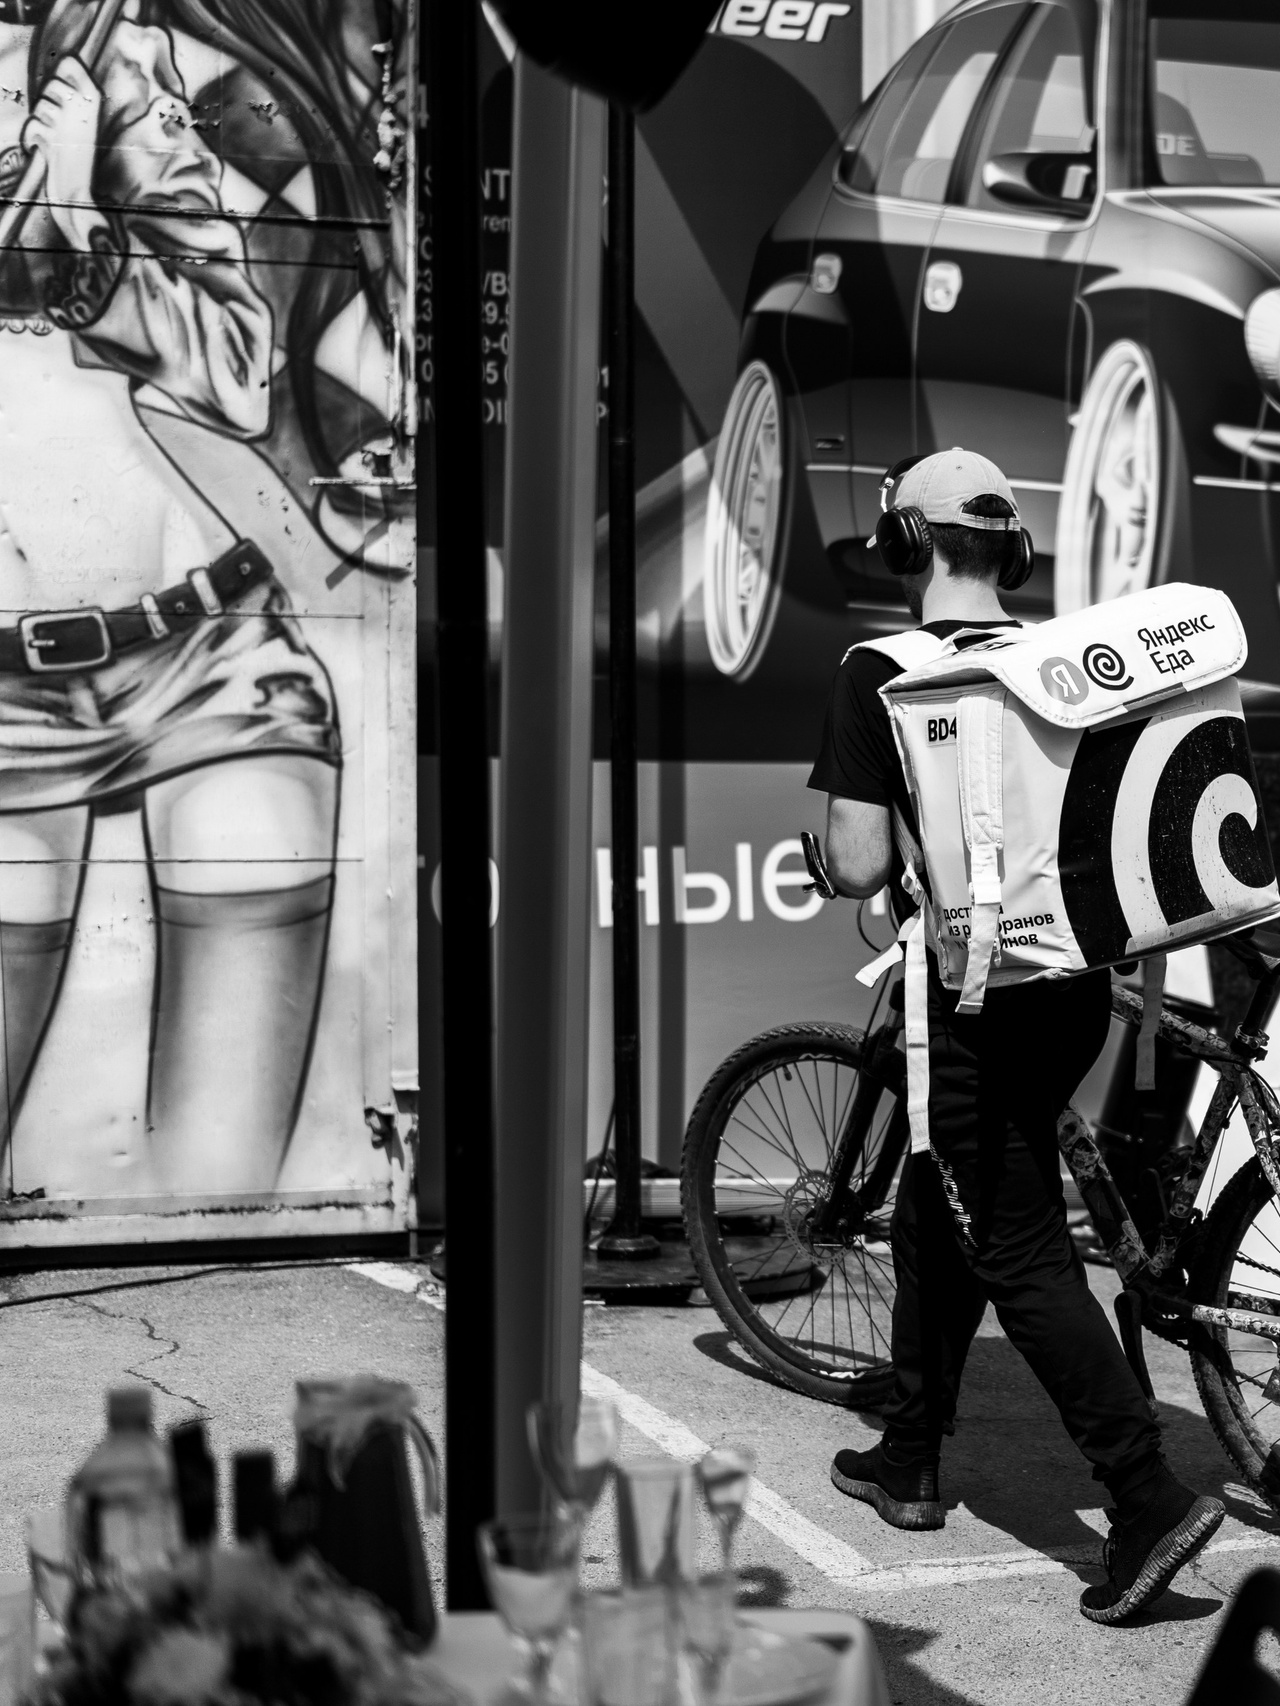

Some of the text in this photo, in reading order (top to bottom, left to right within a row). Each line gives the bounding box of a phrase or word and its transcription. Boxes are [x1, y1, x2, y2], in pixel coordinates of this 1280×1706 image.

[707, 0, 851, 42] eer
[1137, 614, 1216, 651] Яндекс
[1149, 649, 1196, 675] Еда
[1050, 663, 1081, 698] Я
[947, 925, 961, 937] из
